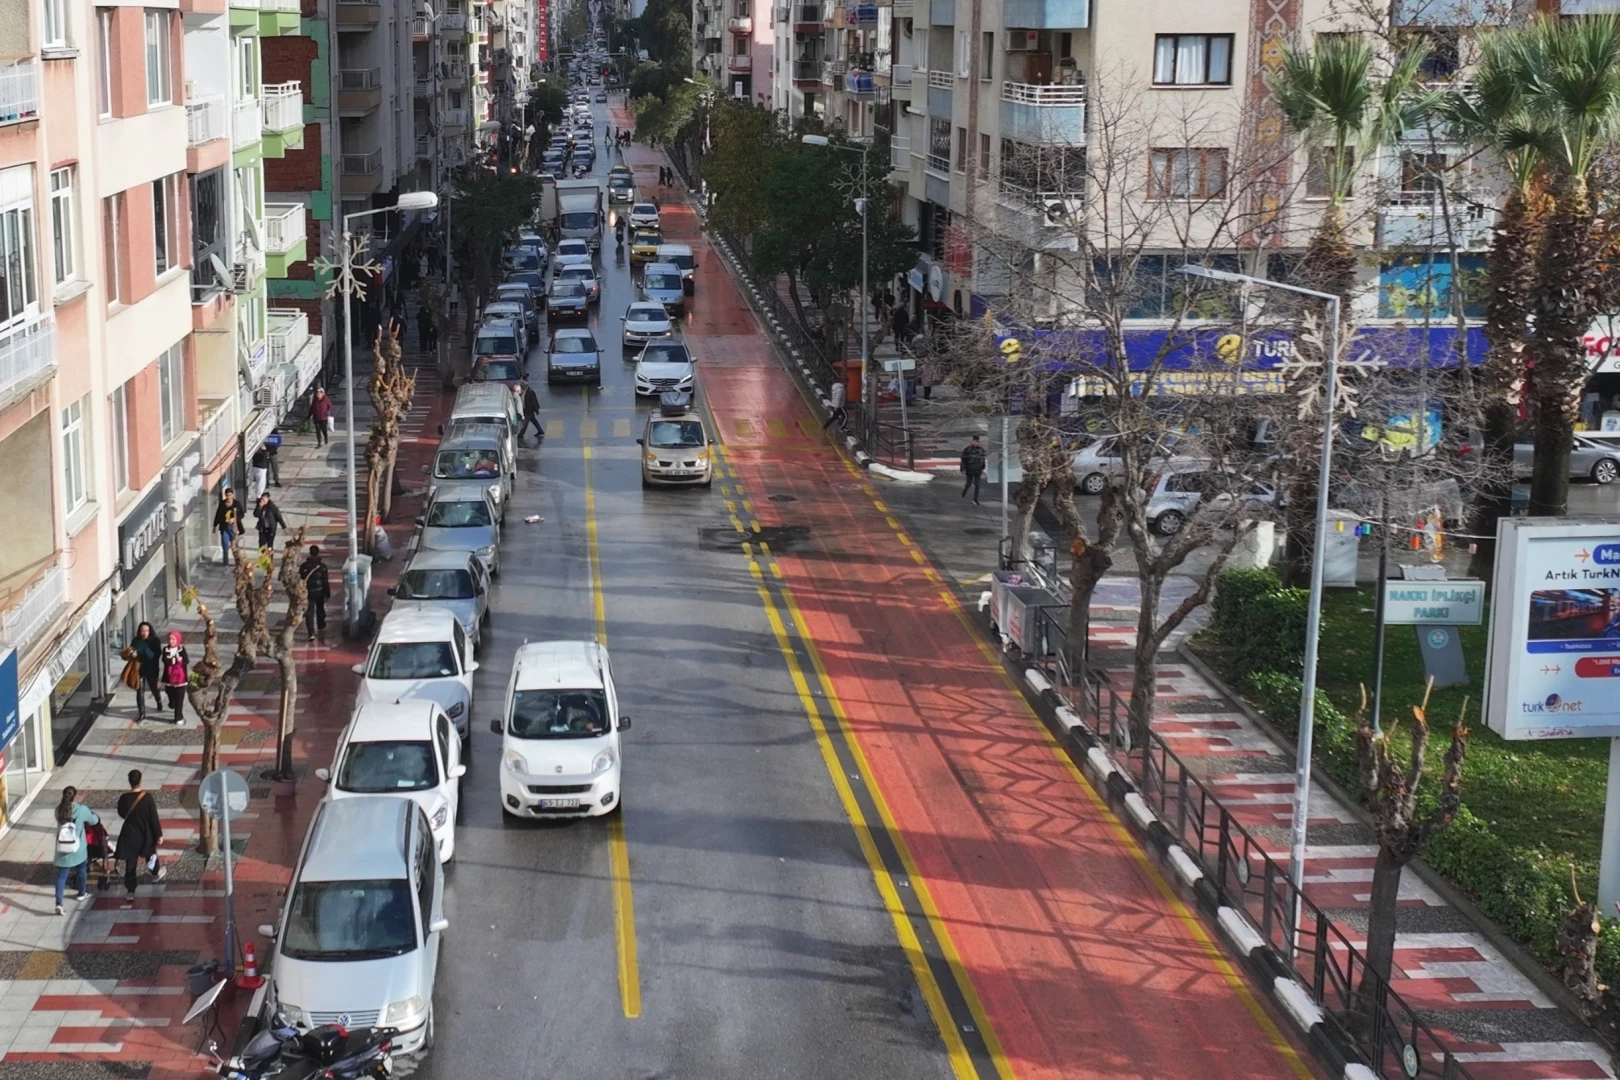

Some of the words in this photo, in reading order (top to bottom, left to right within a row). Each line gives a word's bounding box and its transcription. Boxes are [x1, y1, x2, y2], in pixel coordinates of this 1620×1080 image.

[125, 501, 168, 570] KATMER
[1545, 569, 1577, 580] Artık
[1389, 590, 1427, 601] HAKKI
[1432, 588, 1476, 604] İPLİKÇİ
[1413, 607, 1449, 618] PARKI
[1522, 701, 1544, 712] turk
[1562, 701, 1583, 711] net
